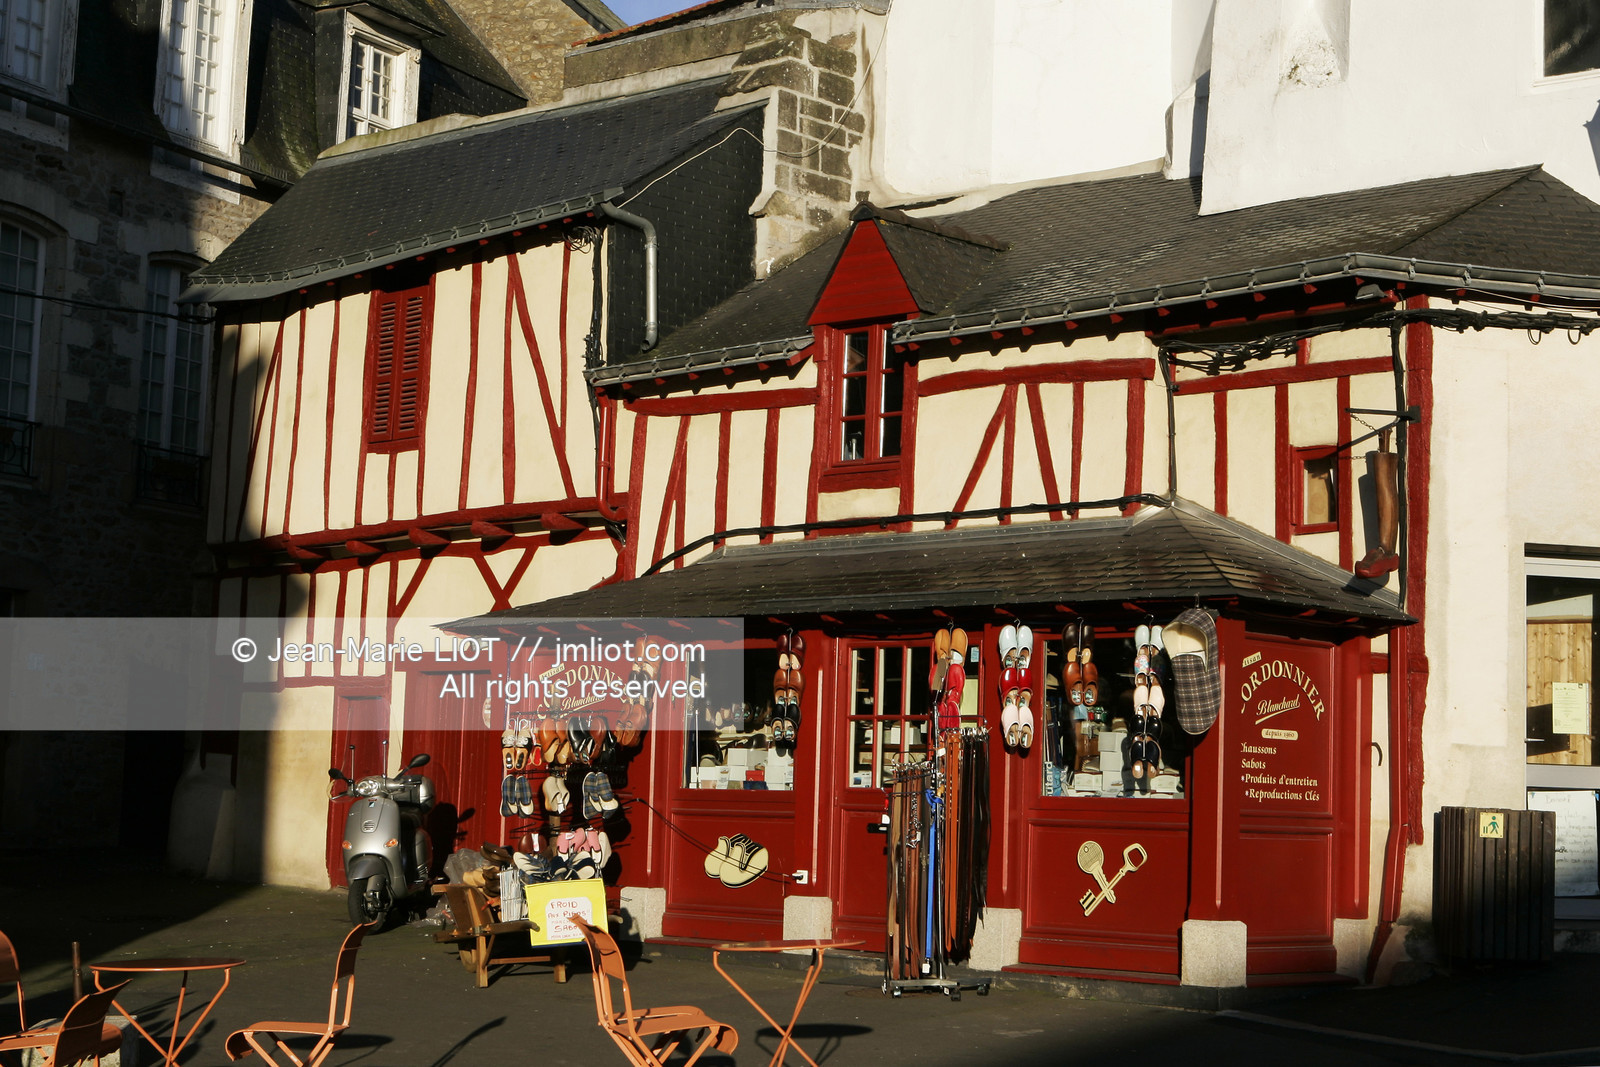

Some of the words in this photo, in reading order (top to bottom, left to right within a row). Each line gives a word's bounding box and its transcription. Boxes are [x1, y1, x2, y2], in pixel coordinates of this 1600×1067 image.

[1241, 659, 1325, 721] ORDONNIER
[1256, 694, 1300, 716] Blanchard
[1265, 730, 1282, 738] depuis
[1241, 758, 1266, 770] Sabots
[1245, 773, 1277, 785] Produits
[1278, 774, 1318, 787] d'entretien
[1249, 788, 1303, 803] Reproductions
[1305, 791, 1320, 802] Clés
[551, 901, 578, 909] FROID
